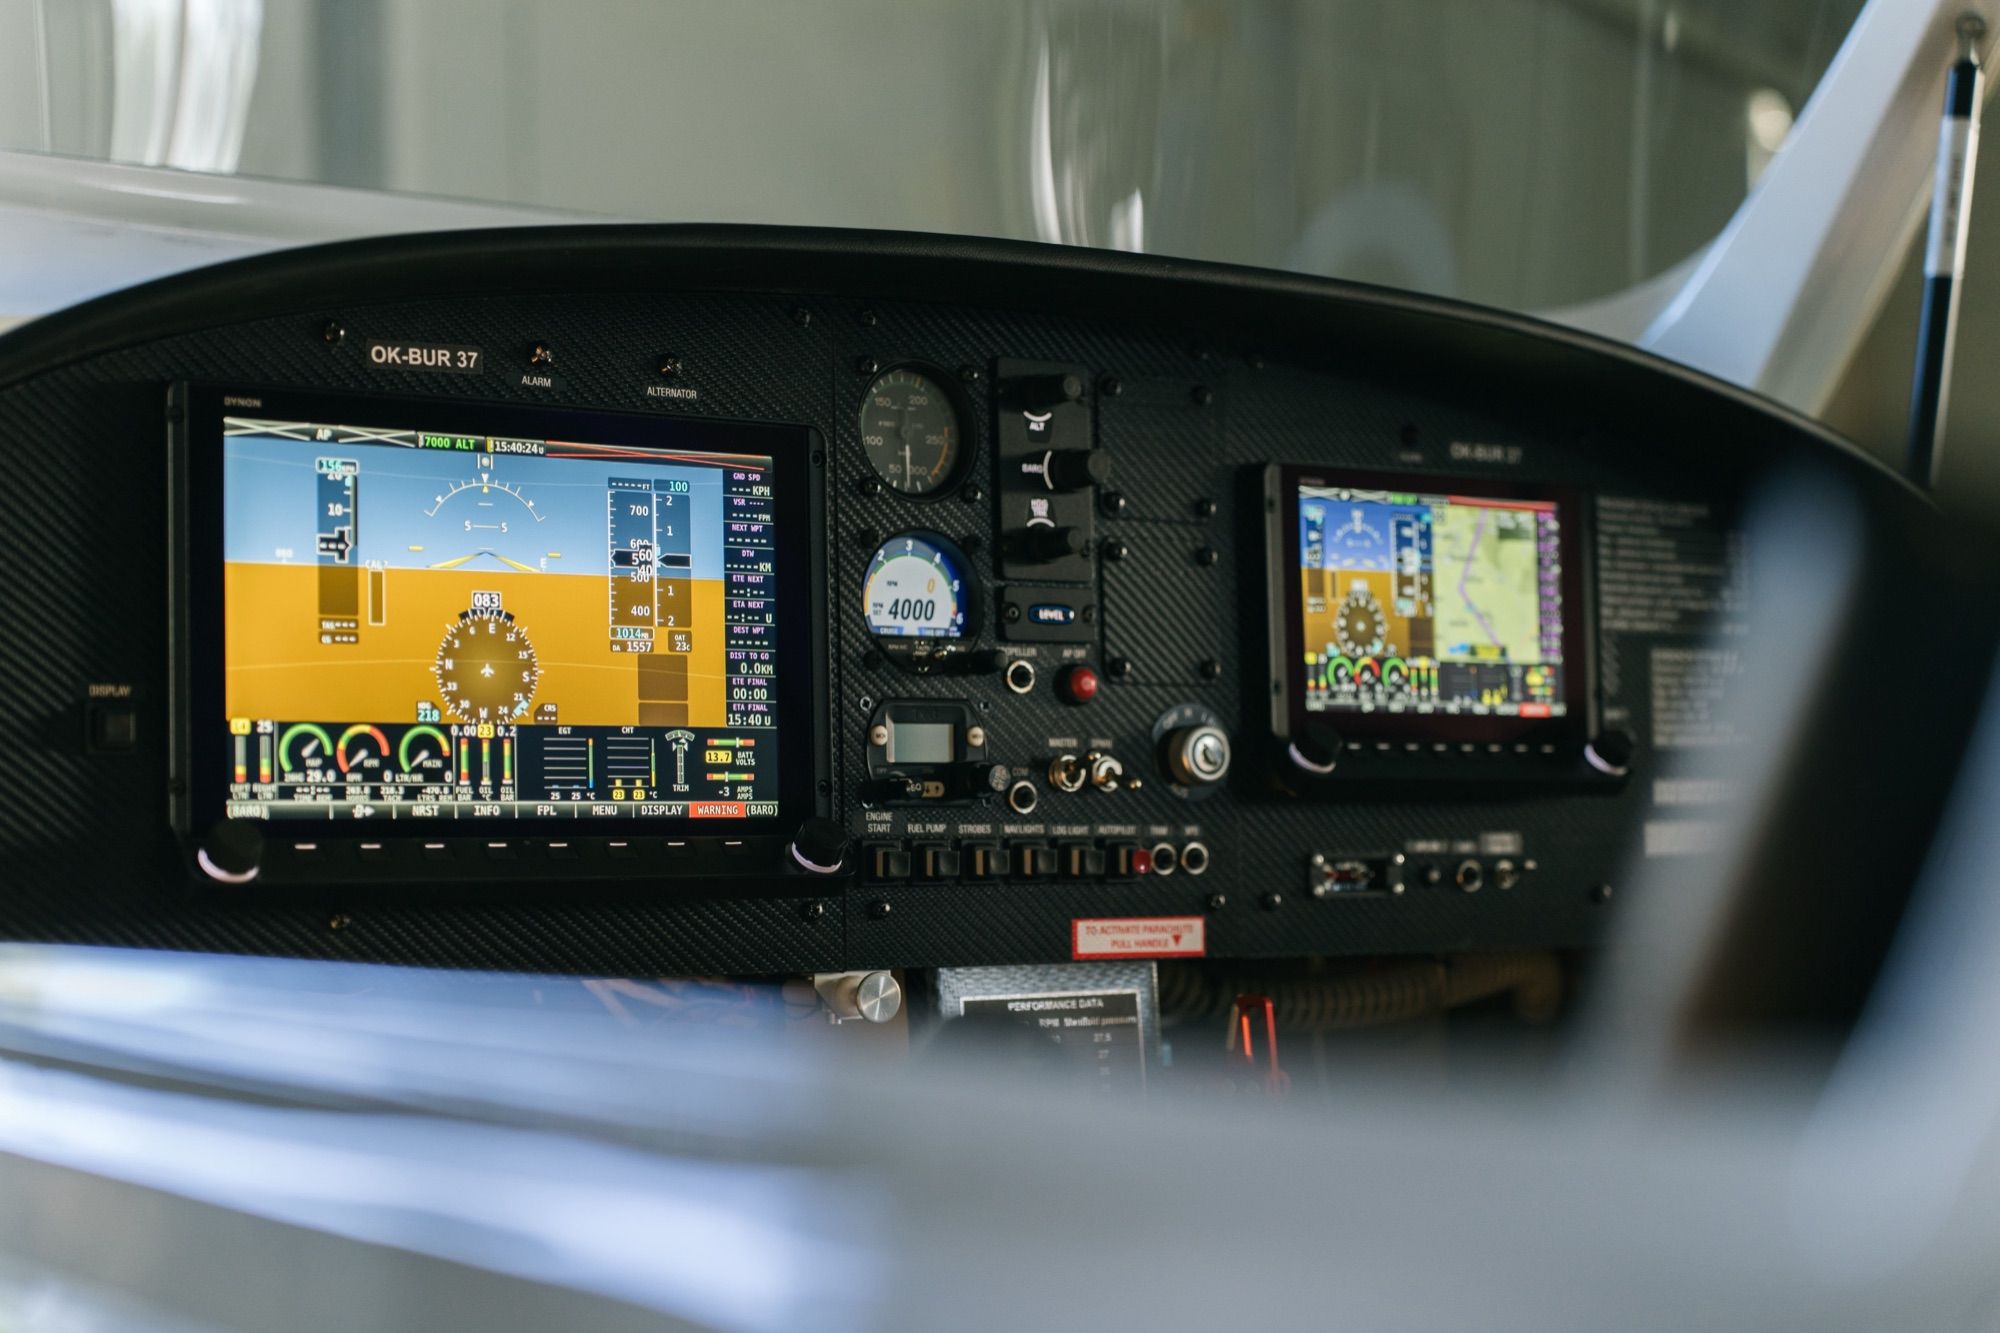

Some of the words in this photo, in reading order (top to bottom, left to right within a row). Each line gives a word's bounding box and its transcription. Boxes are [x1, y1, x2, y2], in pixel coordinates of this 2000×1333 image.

[371, 346, 450, 367] OK-BUR
[456, 352, 478, 369] 37
[522, 376, 551, 388] ALARM
[647, 386, 697, 399] ALTERNATOR
[908, 395, 928, 405] 200
[316, 429, 333, 440] AP
[425, 437, 450, 448] 7000
[455, 439, 475, 450] ALT
[865, 436, 883, 446] 100
[925, 435, 944, 445] 250
[748, 473, 761, 481] SPD
[669, 481, 688, 492] 100
[666, 496, 673, 506] 2
[733, 498, 746, 506] VSR
[328, 503, 343, 516] 10
[630, 505, 649, 516] 700
[464, 520, 472, 531] 5
[501, 522, 508, 533] 5
[732, 524, 748, 532] NEXT
[666, 526, 673, 536] 1
[905, 540, 913, 551] 3
[877, 549, 885, 561] 2
[934, 552, 941, 563] 4
[747, 575, 764, 583] NEXT
[668, 585, 674, 596] 1
[927, 578, 935, 593] 0
[952, 580, 960, 592] 5
[473, 593, 500, 607] 083
[733, 600, 745, 608] ETA
[748, 601, 764, 609] NEXT
[631, 605, 650, 616] 400
[888, 598, 935, 621] 4000
[668, 616, 674, 626] 2
[469, 627, 476, 635] 6
[488, 623, 496, 634] E
[733, 626, 749, 634] DEST
[752, 627, 765, 635] WPT
[506, 633, 516, 642] 12
[454, 640, 460, 648] 3
[627, 641, 652, 652] 1557
[518, 651, 528, 659] 15
[749, 652, 758, 660] TO
[445, 660, 453, 670] N
[523, 672, 530, 682] S
[747, 678, 768, 686] FINAL
[514, 692, 523, 701] 21
[733, 688, 767, 700] 00:00
[460, 700, 470, 708] 30
[733, 703, 745, 711] ETA
[479, 708, 488, 718] W
[498, 705, 509, 714] 24
[417, 710, 440, 722] 218
[728, 714, 762, 726] 15:40
[256, 720, 273, 734] 25
[451, 725, 476, 736] 0.00
[497, 726, 516, 736] 0.2
[558, 727, 572, 735] EGT
[621, 726, 634, 734] CHT
[707, 752, 731, 762] 13.7
[737, 751, 753, 759] BATT
[363, 758, 379, 768] RPM
[422, 759, 442, 768] MAIN
[735, 758, 755, 766] VOLTS
[306, 769, 336, 783] 29.0
[383, 769, 392, 783] 0
[444, 770, 453, 783] 0
[456, 786, 473, 794] FUEL
[479, 786, 493, 794] OIL
[500, 786, 514, 794] OIL
[672, 784, 689, 792] TRIM
[718, 786, 730, 797] -3
[550, 792, 560, 800] 25
[571, 792, 581, 800] 25
[412, 805, 439, 816] NRST
[474, 805, 500, 816] INFO
[537, 806, 557, 815] FPL
[592, 805, 618, 815] MENU
[641, 805, 683, 815] DISPLAY
[697, 805, 738, 815] WARNING
[746, 805, 778, 816] (BARO)
[866, 812, 893, 822] ENGINE
[867, 823, 891, 833] START
[907, 823, 925, 833] FUEL
[926, 823, 946, 833] PUMP
[958, 824, 992, 834] STROBES
[1098, 825, 1136, 834] AUTOPILOT
[1008, 999, 1077, 1011] PERFORMANCE
[1079, 998, 1104, 1010] DATA
